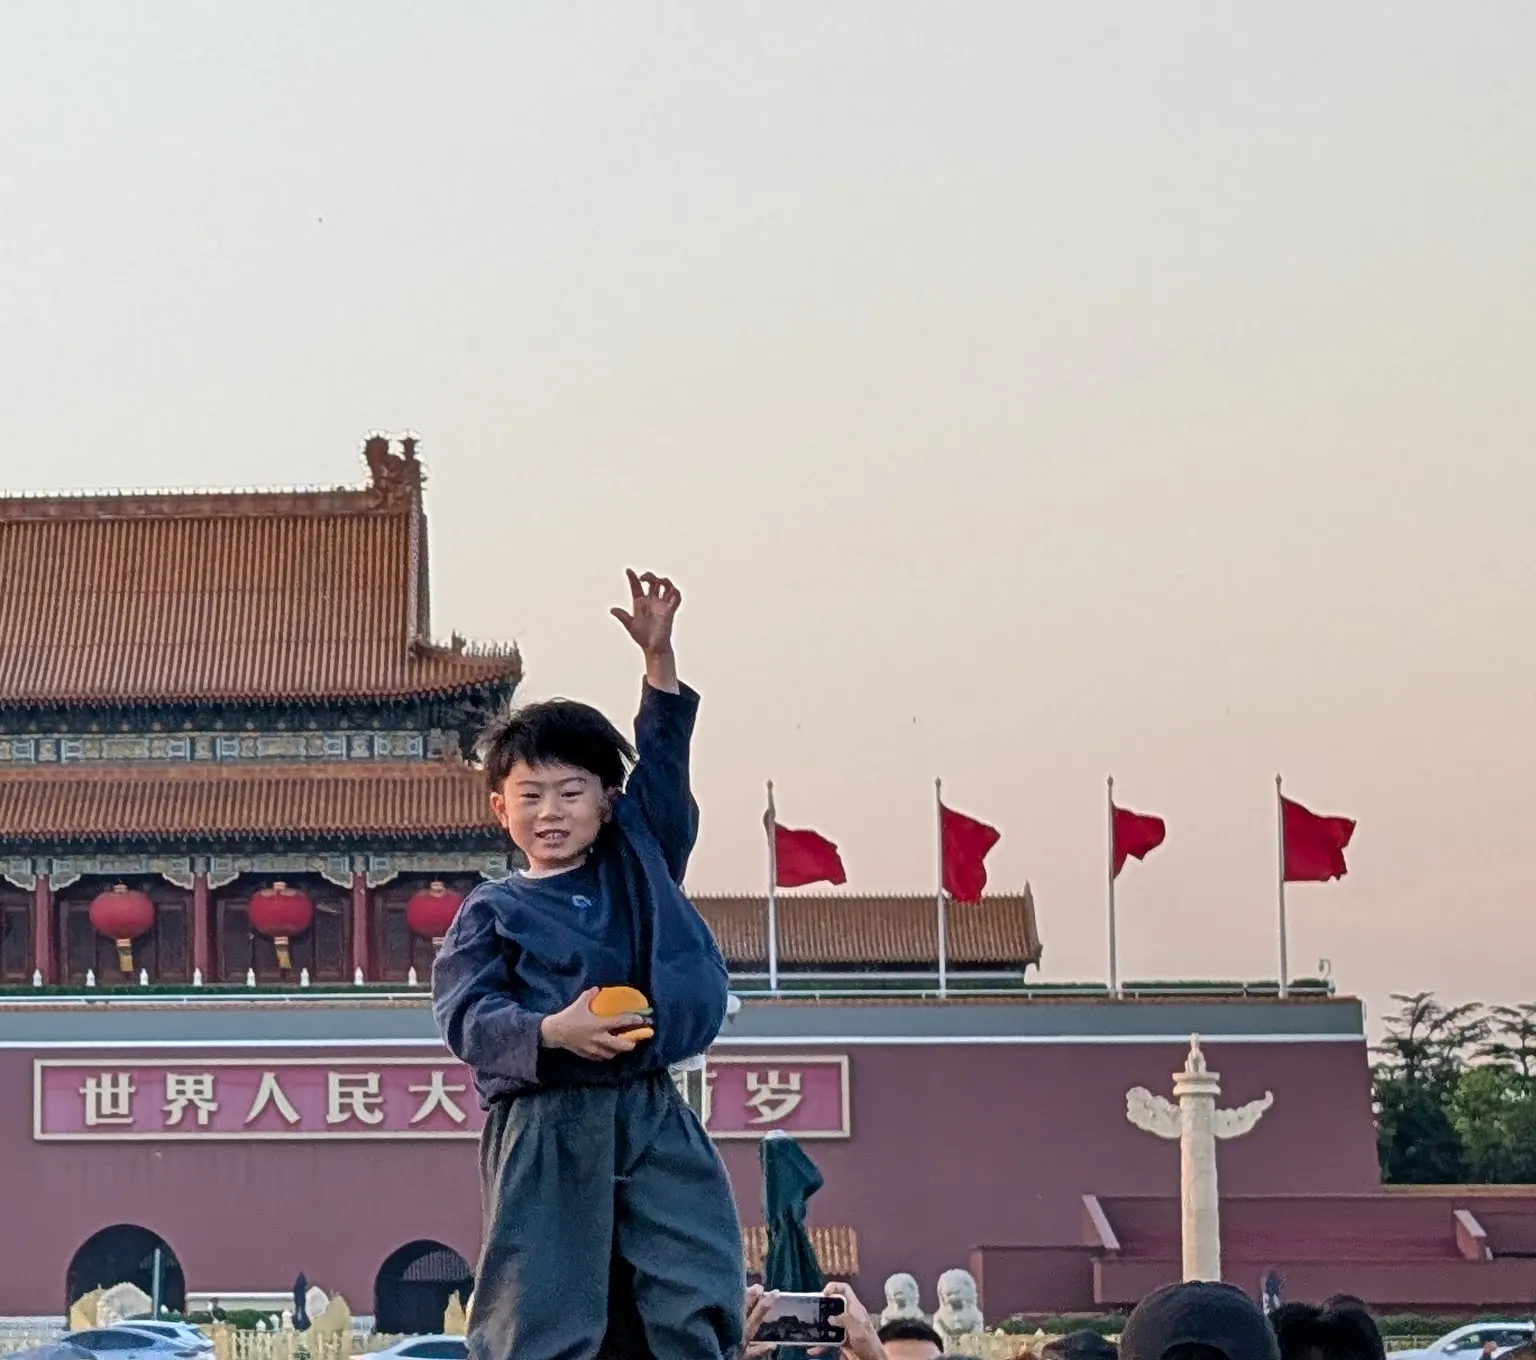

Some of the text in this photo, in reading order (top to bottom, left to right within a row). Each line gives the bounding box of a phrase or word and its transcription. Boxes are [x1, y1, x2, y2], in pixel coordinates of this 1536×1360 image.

[79, 1069, 803, 1126] 世界人民大岁
